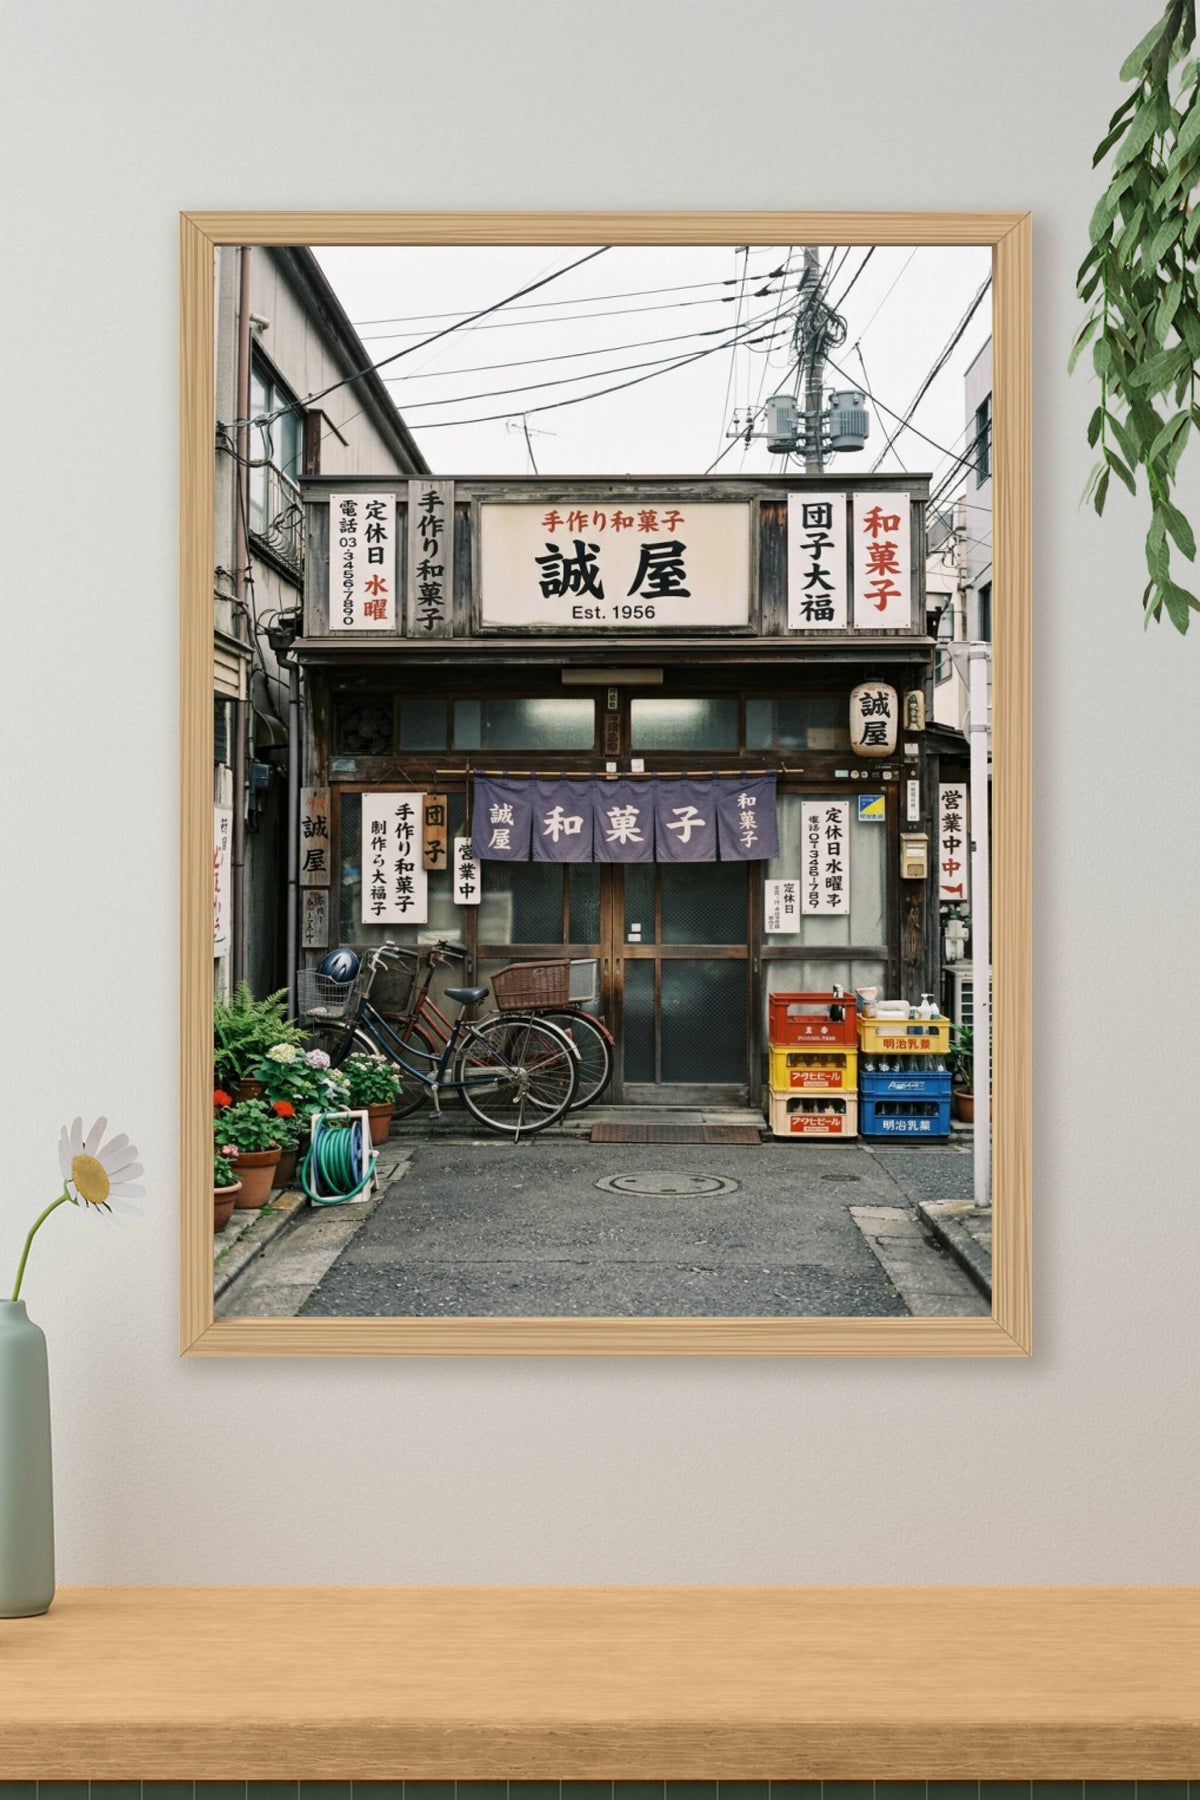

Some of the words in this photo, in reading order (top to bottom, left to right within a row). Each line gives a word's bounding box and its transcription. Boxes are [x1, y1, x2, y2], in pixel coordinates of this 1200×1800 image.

[541, 509, 685, 533] 手作り和菓子
[416, 490, 445, 631] 手作り和菓子
[535, 540, 691, 600] 誠屋
[800, 502, 836, 622] 団子大福
[863, 506, 902, 612] 和菓子
[572, 605, 606, 619] Est.
[612, 605, 655, 619] 1956
[859, 692, 891, 747] 誠屋
[302, 816, 328, 872] 誠屋
[424, 805, 445, 863] 団子
[488, 803, 514, 850] 誠屋
[543, 805, 706, 844] 和菓子
[736, 793, 759, 848] 和菓子
[394, 803, 415, 913] 手作り和菓子
[459, 843, 476, 900] 営業中
